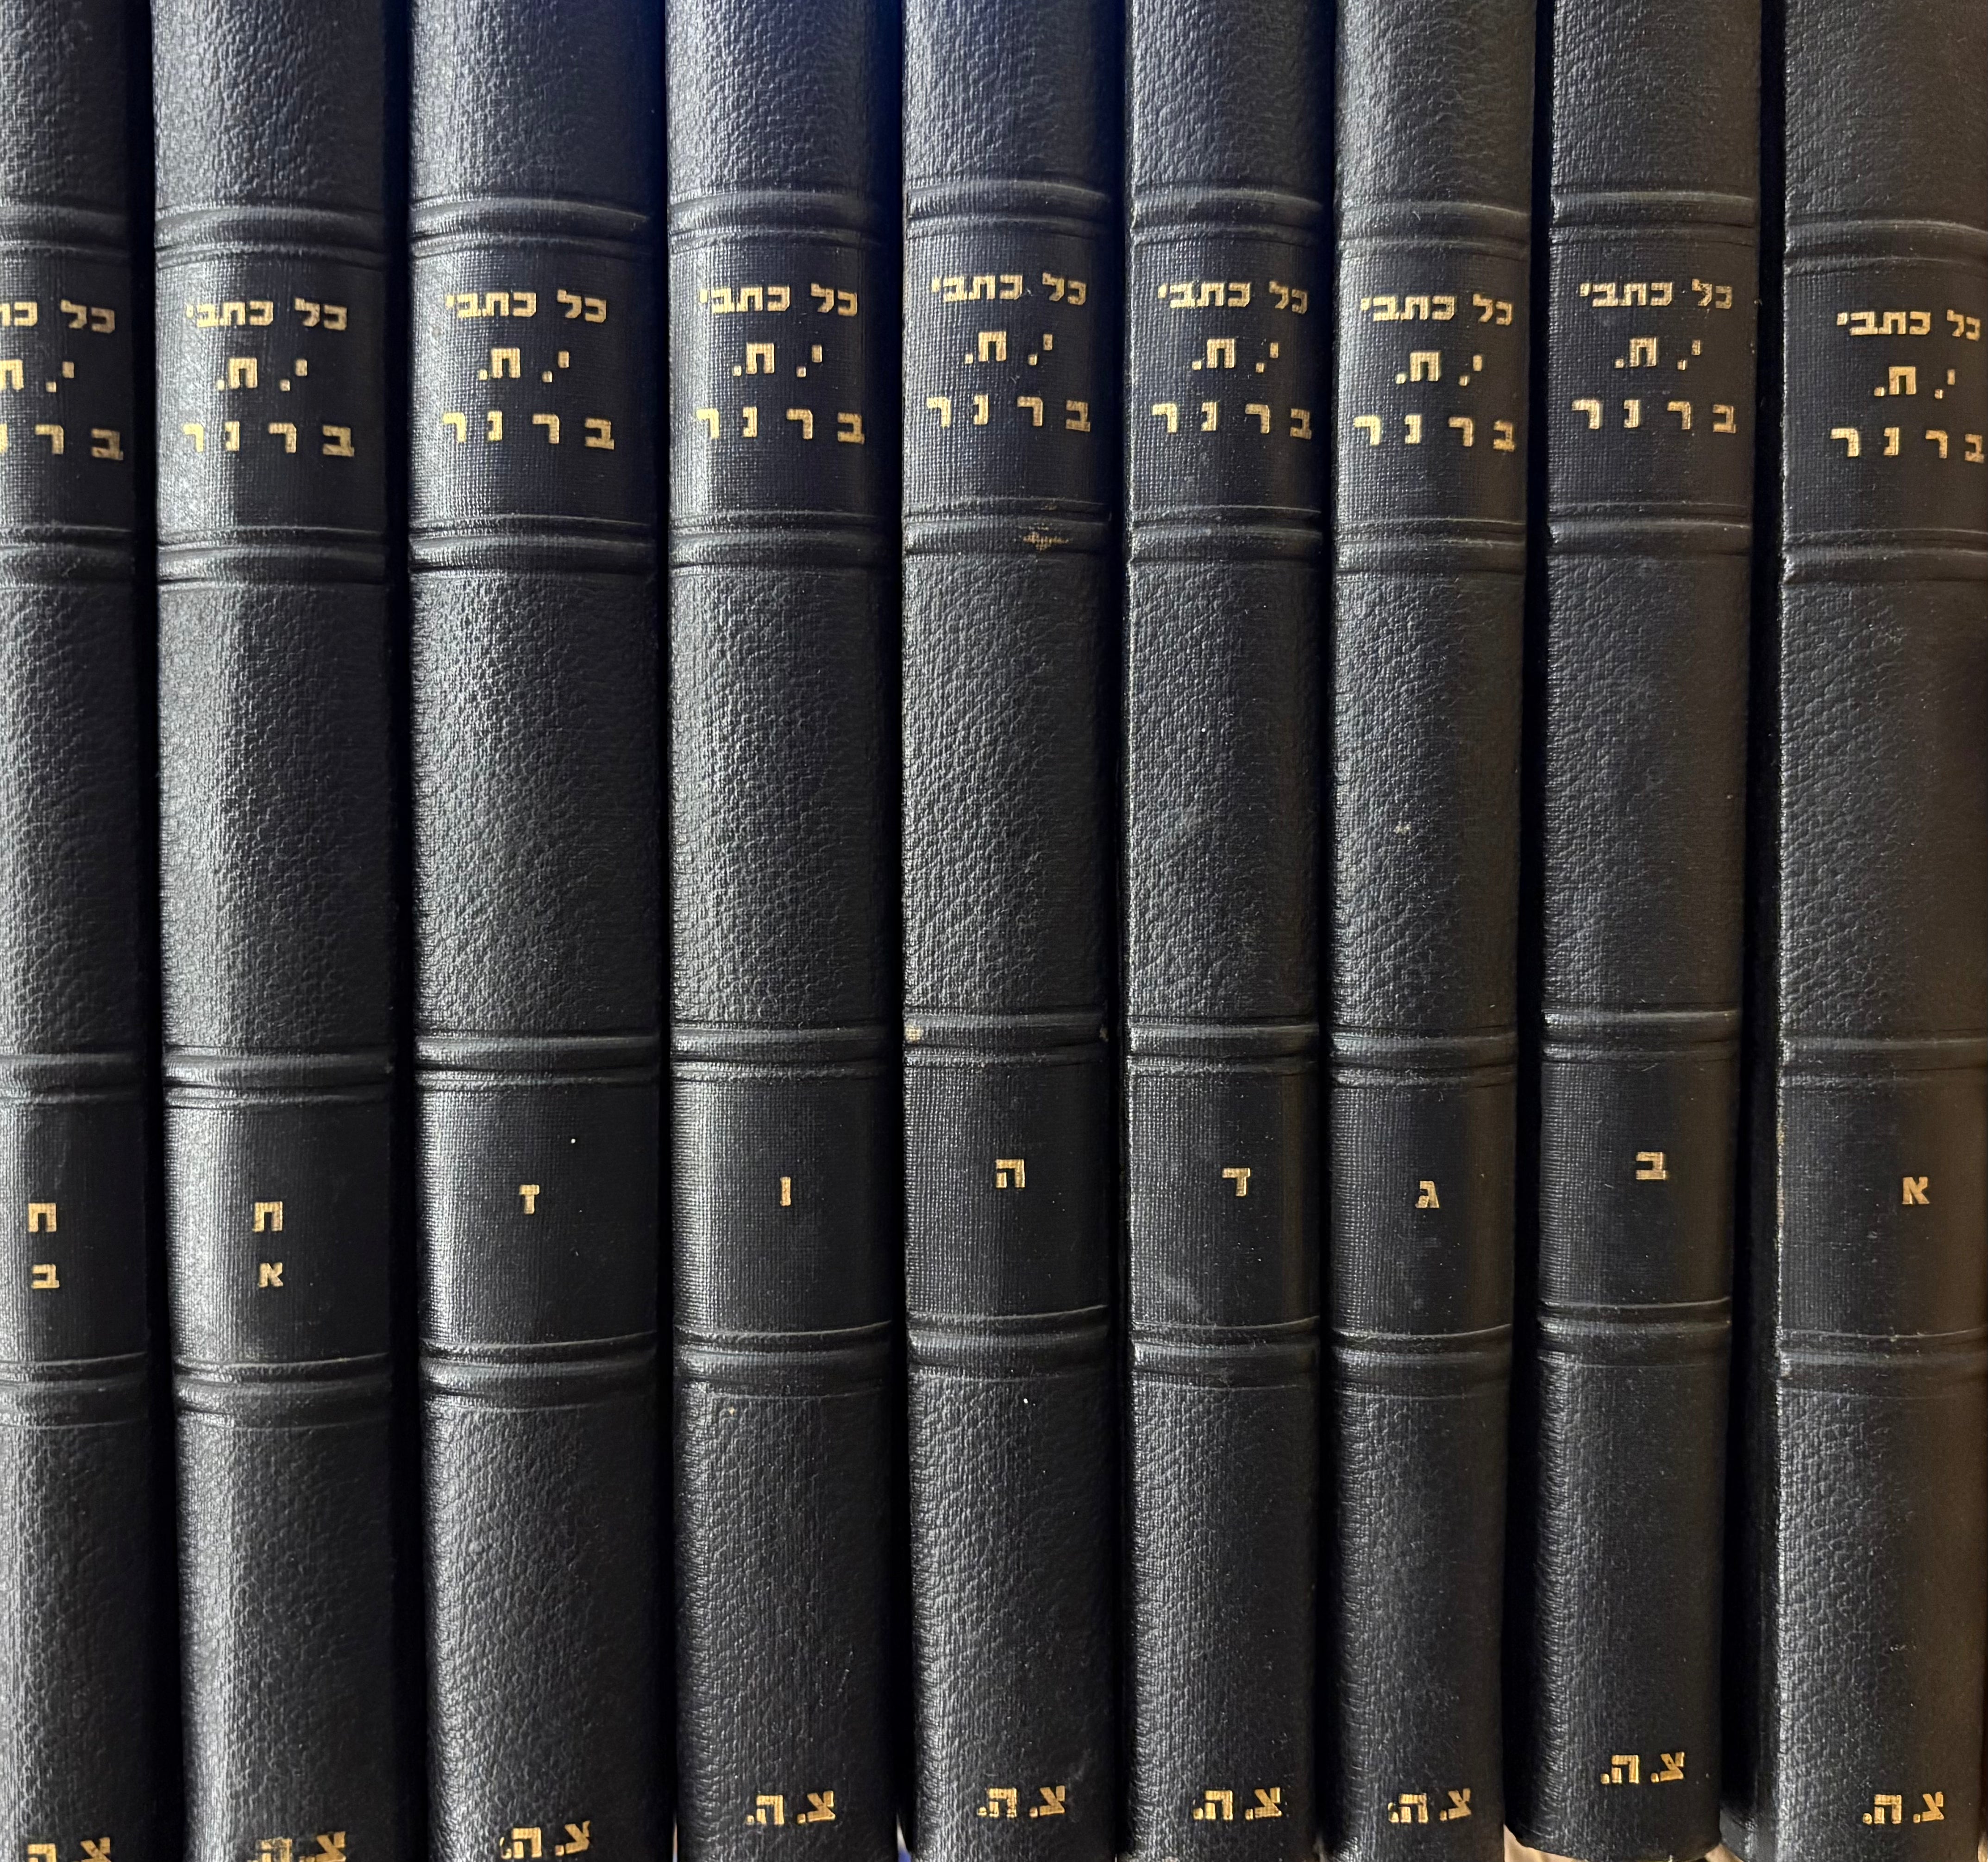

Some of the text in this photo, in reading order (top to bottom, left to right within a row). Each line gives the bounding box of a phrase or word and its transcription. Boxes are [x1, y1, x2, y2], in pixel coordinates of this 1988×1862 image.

[445, 289, 607, 323] כל כתבי
[700, 283, 858, 316] כל כתבי
[931, 273, 1086, 305] כל כתבי
[1158, 281, 1308, 313] כל כתבי
[1580, 278, 1732, 309] כל כתבי
[61, 299, 115, 333] כל
[186, 298, 347, 330] כל כתבי
[1360, 293, 1513, 326] כל כתבי
[1837, 309, 1981, 341] כל כתבי
[478, 348, 569, 382] י. ח.
[733, 343, 822, 377] י. ח.
[965, 331, 1053, 365] י. ח.
[1192, 339, 1279, 373] י. ח.
[1615, 337, 1701, 371] י. ח.
[46, 361, 74, 393] י.
[216, 357, 307, 391] י. ח.
[1395, 352, 1483, 386] י. ח.
[1874, 366, 1956, 400] י. ח.
[442, 411, 615, 450] ברנר
[696, 407, 865, 444] ברנר
[927, 395, 1091, 432] ברנר
[1152, 402, 1312, 439] ברנר
[1572, 399, 1737, 434] ברנר
[183, 421, 354, 456] ברנר
[1353, 415, 1516, 453] ברנר
[1830, 427, 1985, 464] ברנר
[996, 1159, 1025, 1189] ה
[1223, 1168, 1251, 1197] ד
[1636, 1152, 1668, 1181] ב
[519, 1184, 540, 1214] ז
[781, 1176, 791, 1206] ו
[1415, 1181, 1440, 1209] ג
[1902, 1176, 1930, 1205] א
[28, 1202, 57, 1233] ח
[253, 1201, 283, 1233] ח
[31, 1264, 60, 1289] ב
[258, 1263, 283, 1288] א
[1600, 1752, 1685, 1785] צ. ה.
[746, 1791, 836, 1826] צ. ה.
[977, 1785, 1065, 1818] צ. ה.
[1192, 1787, 1282, 1821] צ. ה.
[1388, 1788, 1472, 1824] צ. ה.
[1862, 1791, 1944, 1825] צ. ה.
[500, 1820, 590, 1860] צ. ה.
